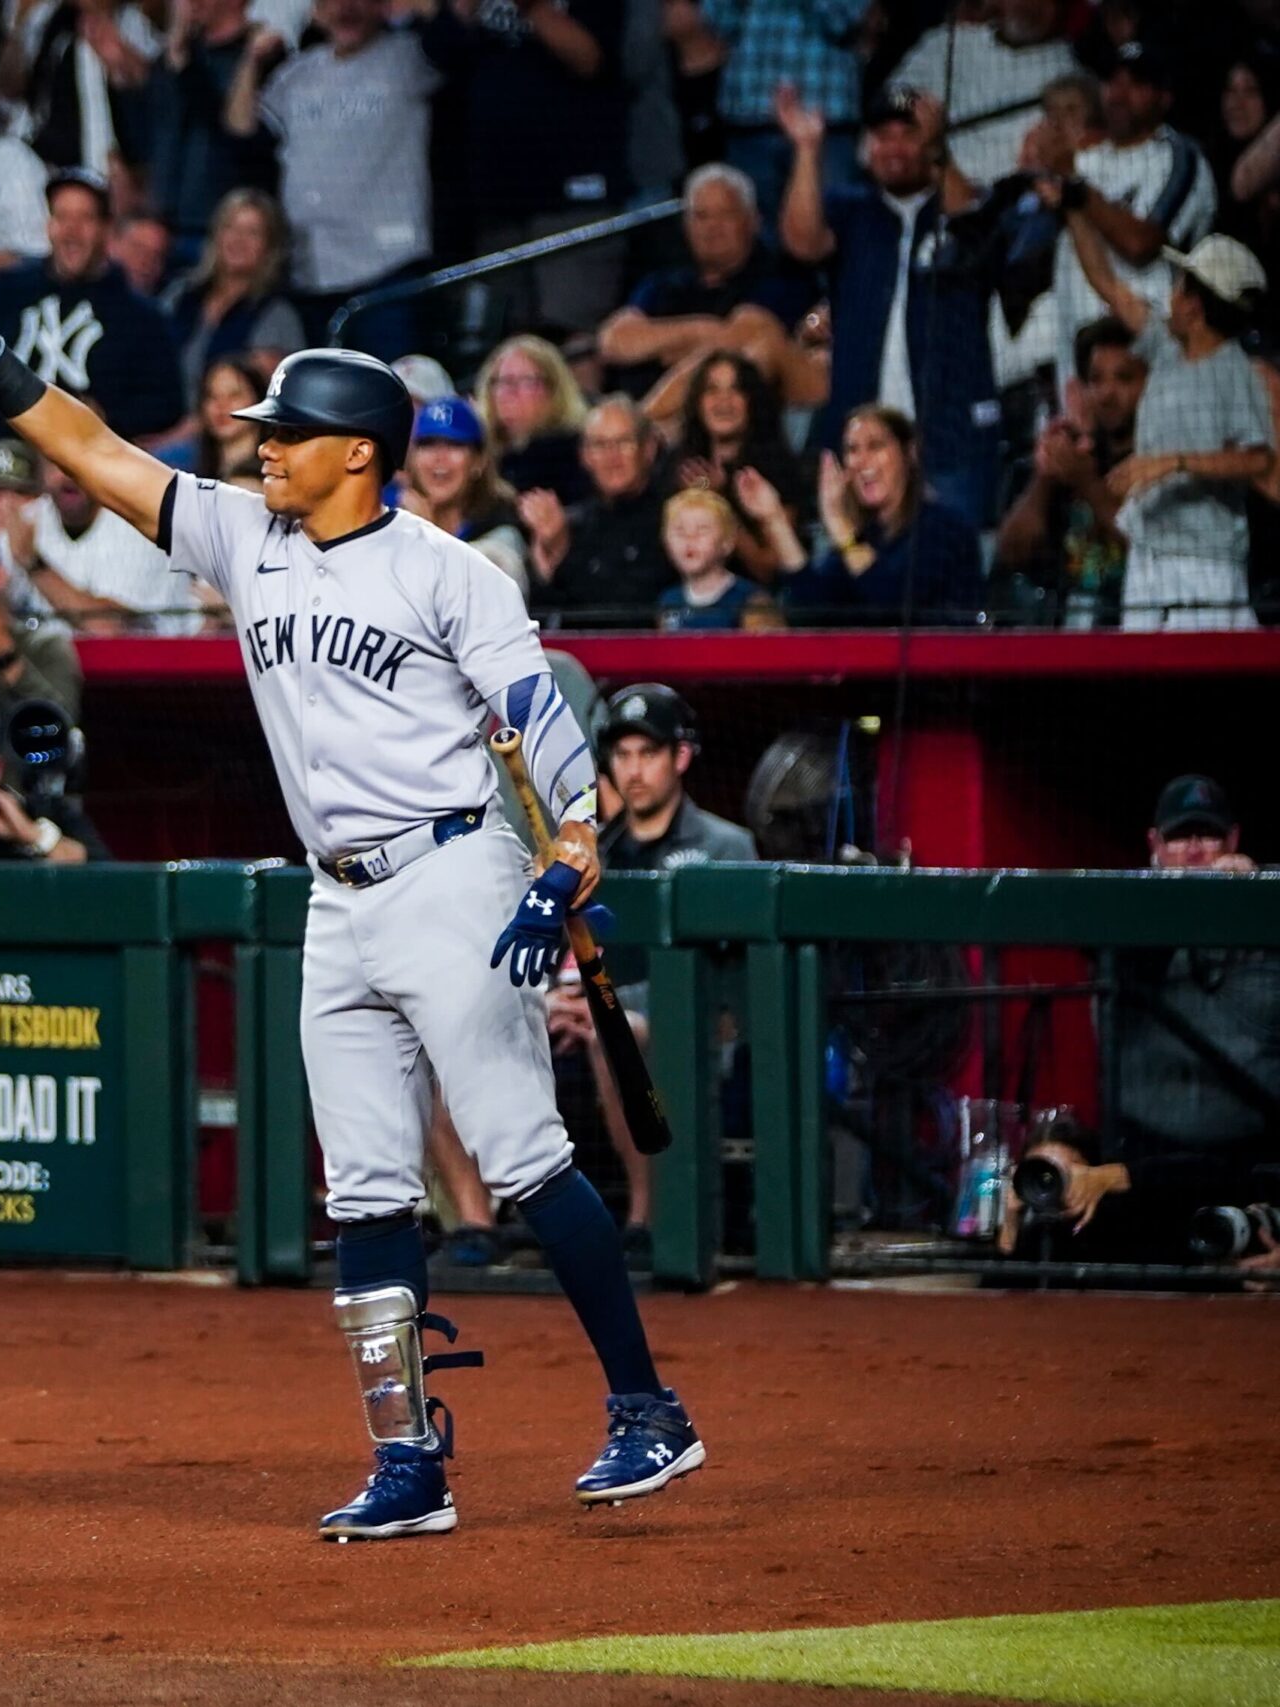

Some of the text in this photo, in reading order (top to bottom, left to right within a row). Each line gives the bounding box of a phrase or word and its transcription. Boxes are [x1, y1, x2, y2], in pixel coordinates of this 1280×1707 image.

[13, 293, 104, 389] NY
[246, 614, 416, 692] NEW YORK
[367, 858, 388, 876] 22
[65, 1076, 102, 1145] IT
